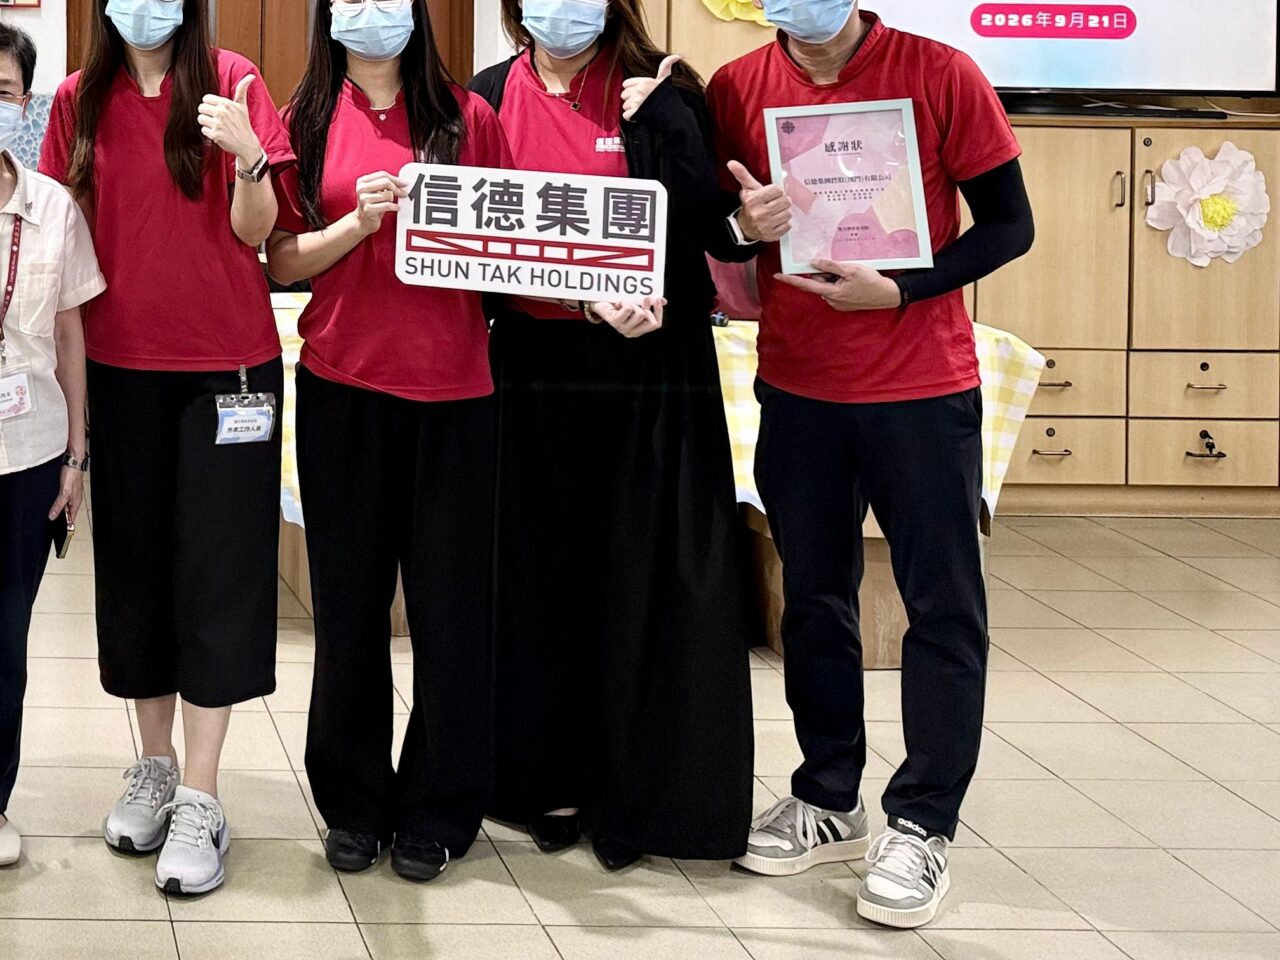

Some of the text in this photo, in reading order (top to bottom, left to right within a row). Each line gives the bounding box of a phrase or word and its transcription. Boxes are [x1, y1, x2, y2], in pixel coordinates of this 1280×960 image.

[980, 10, 1128, 30] 2026年9月21日
[407, 173, 658, 243] 信德集團
[404, 257, 654, 295] SHUN TAK HOLDINGS
[898, 818, 927, 836] adidas
